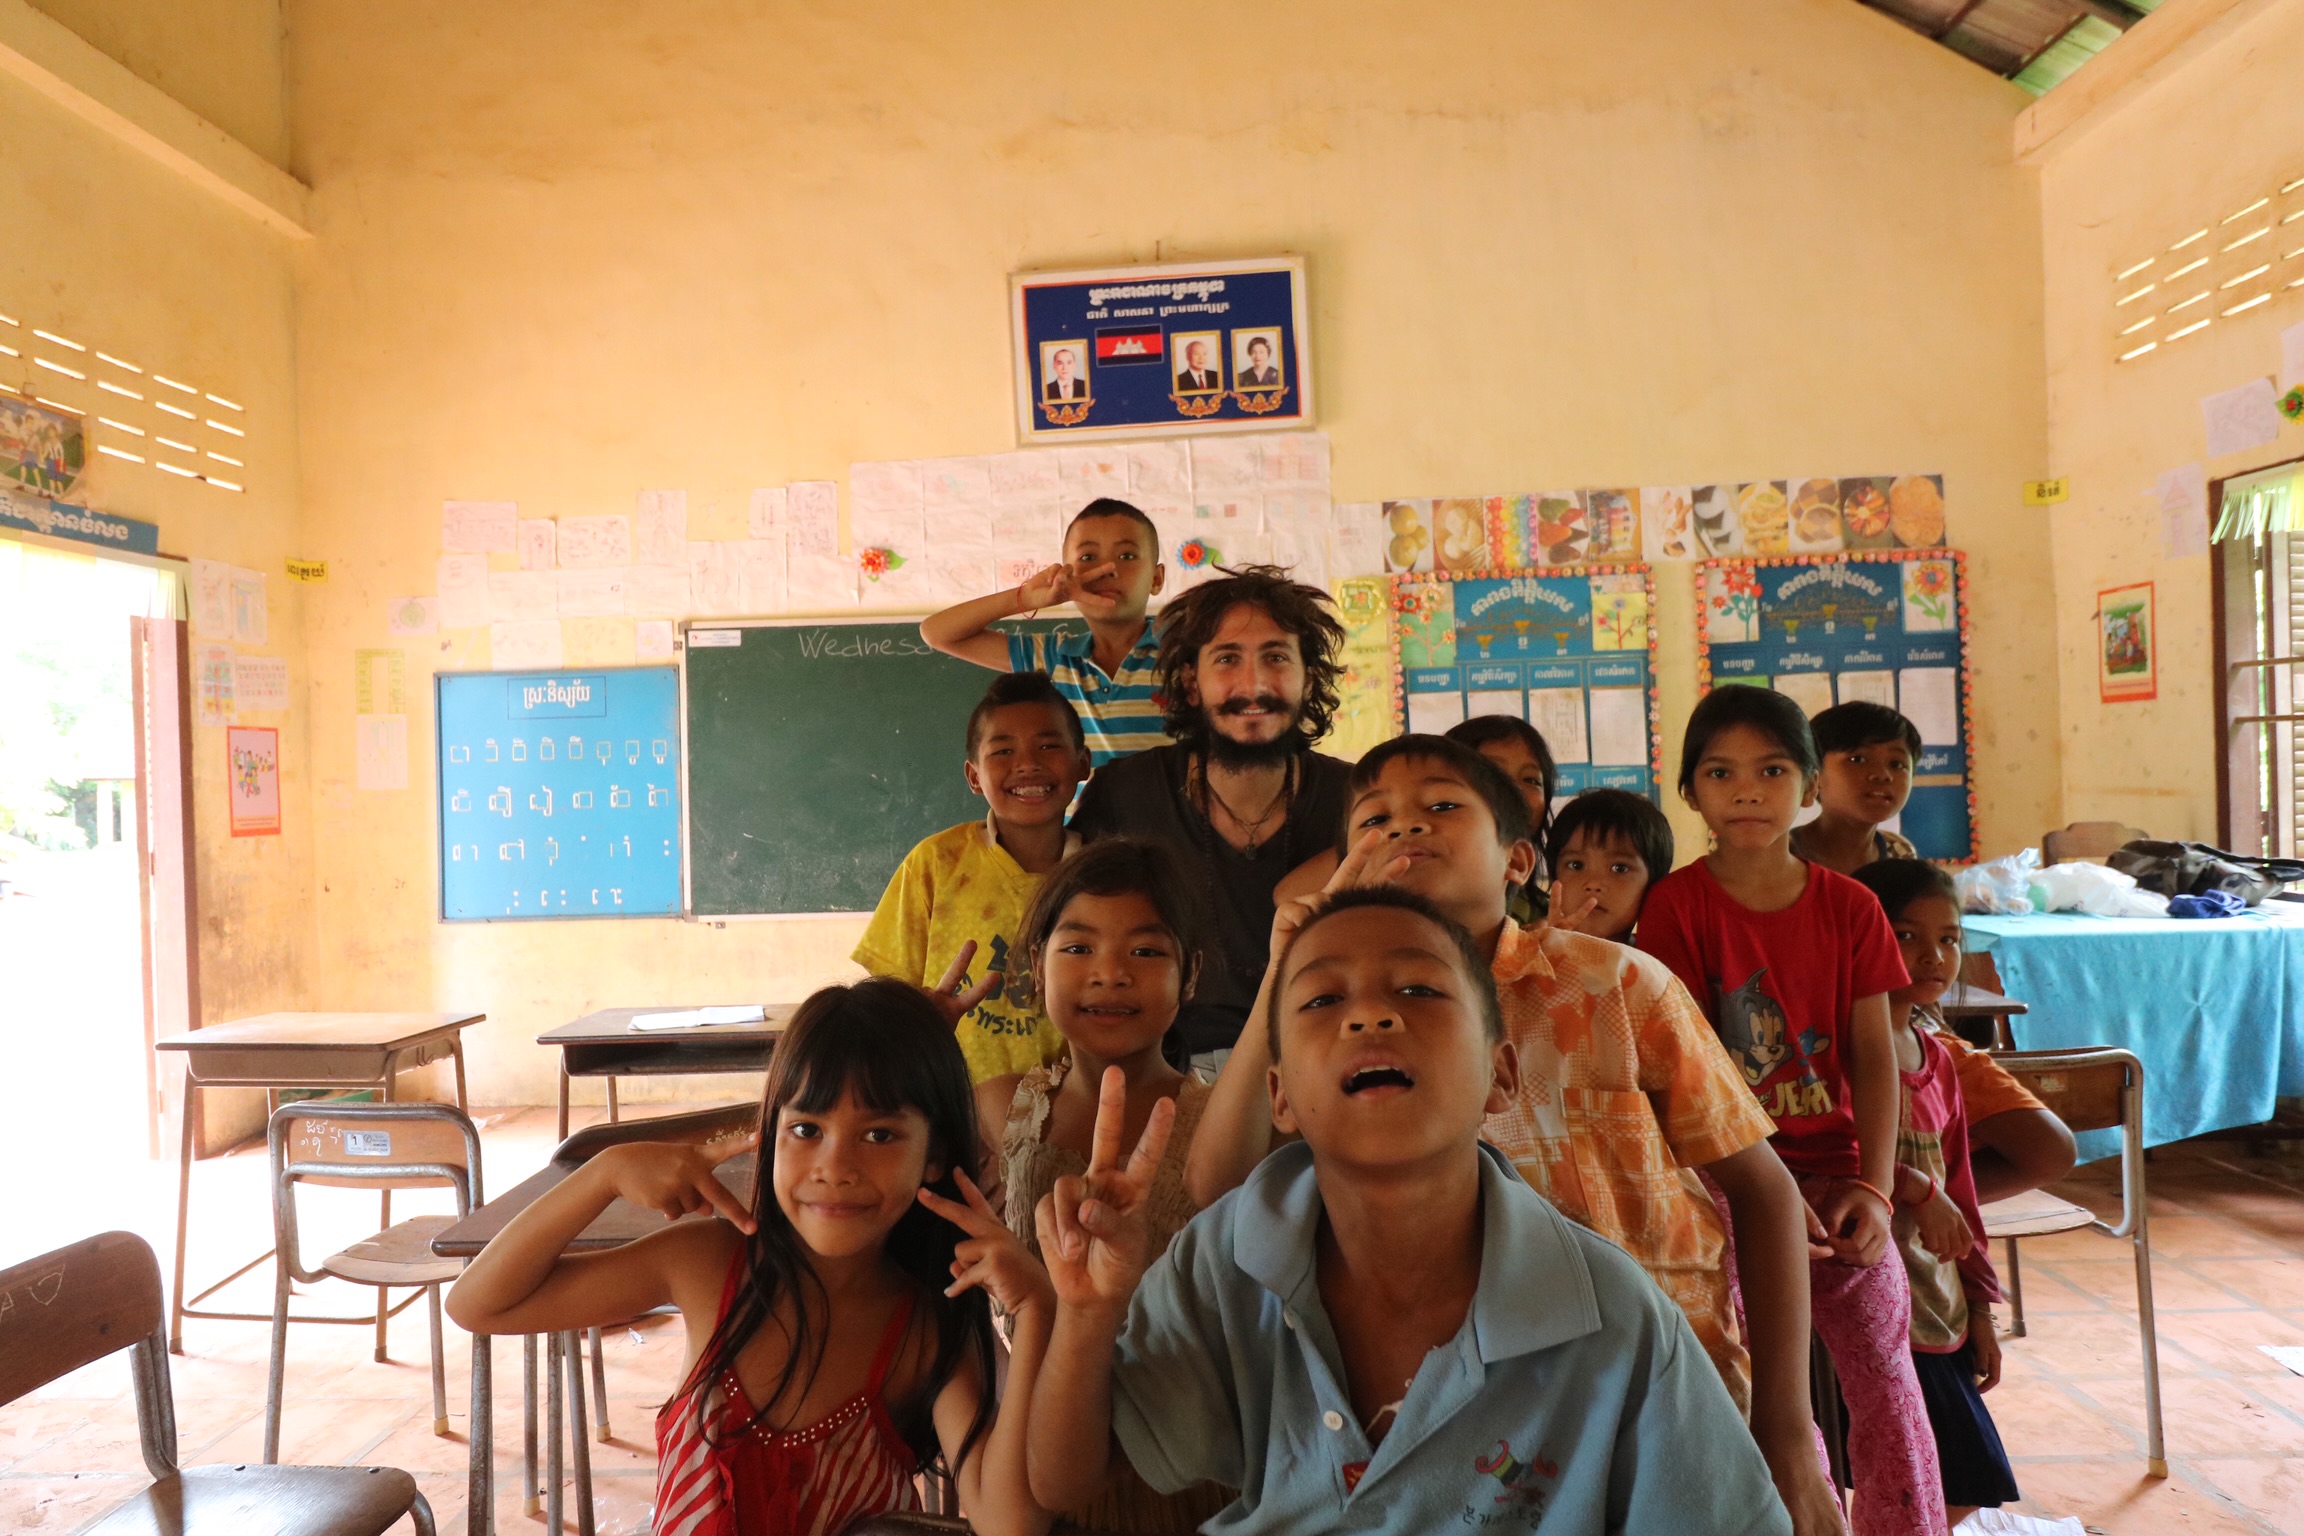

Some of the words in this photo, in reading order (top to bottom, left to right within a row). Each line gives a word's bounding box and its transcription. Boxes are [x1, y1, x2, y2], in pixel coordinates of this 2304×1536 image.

[1086, 307, 1108, 319] ជាតិ
[1113, 306, 1154, 318] សាសនា
[798, 628, 939, 659] Wednesd
